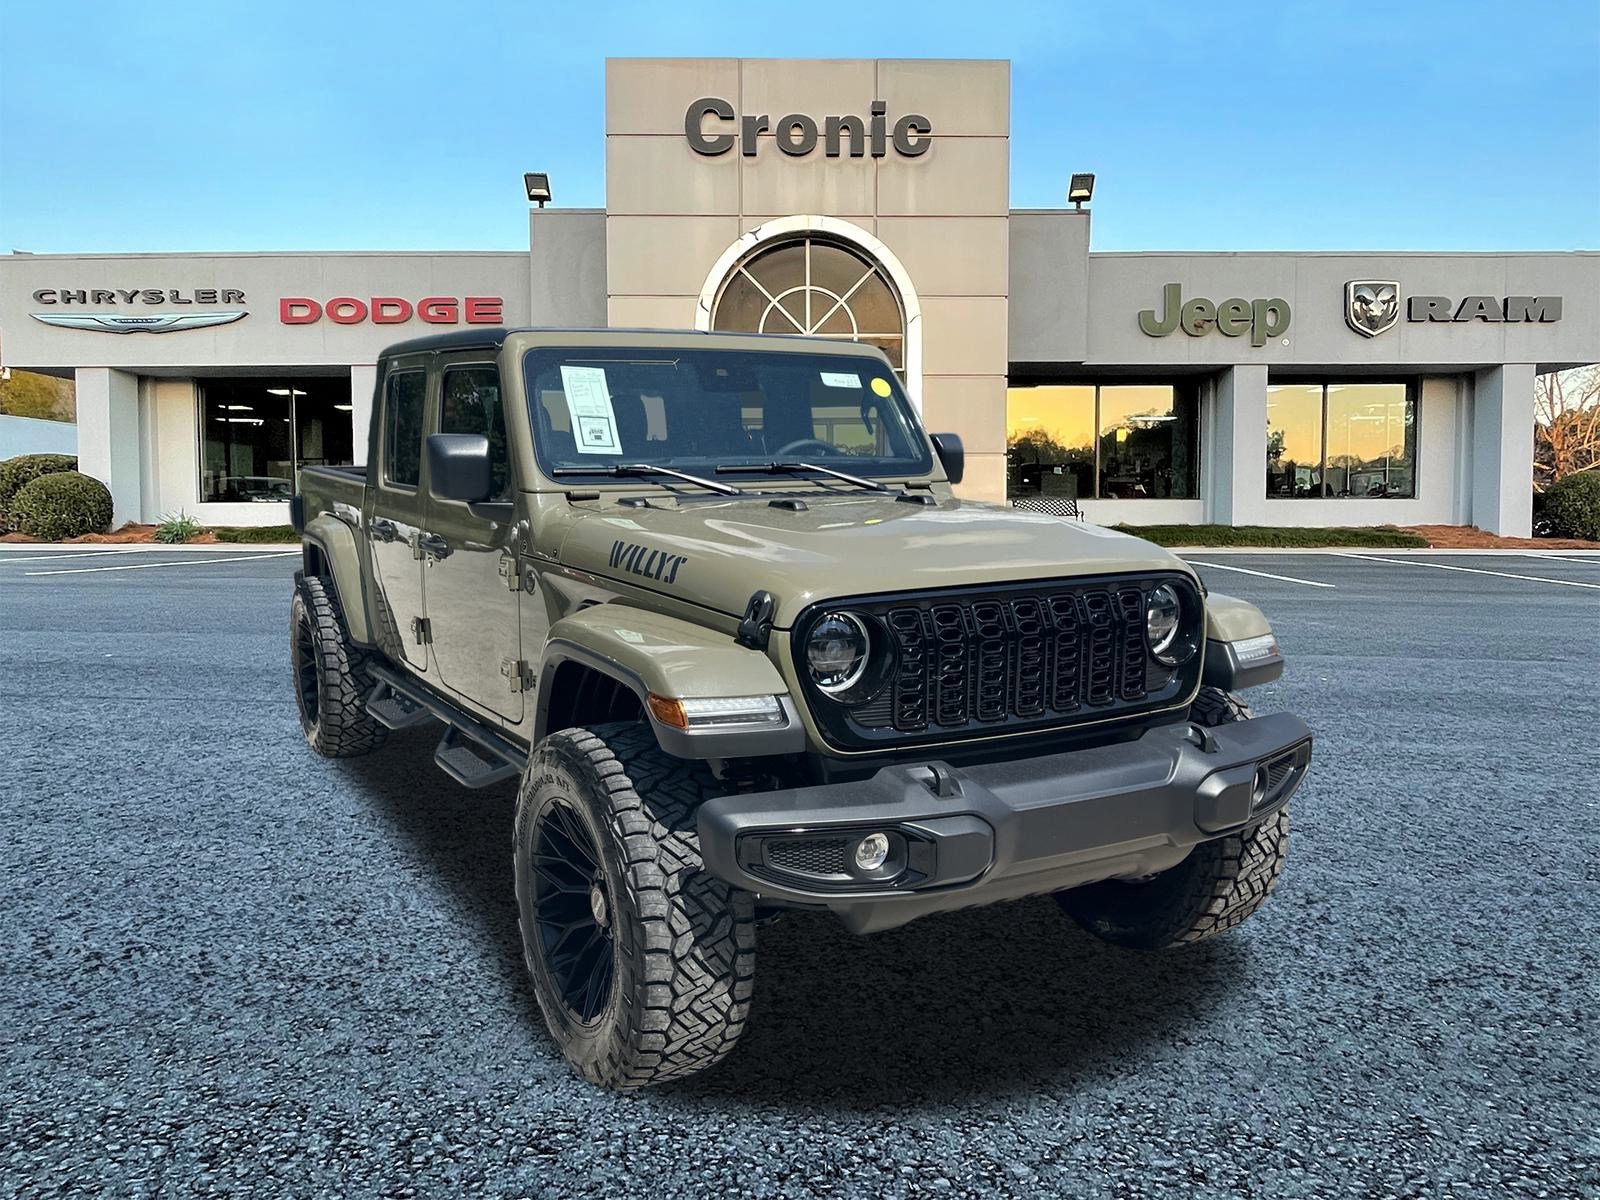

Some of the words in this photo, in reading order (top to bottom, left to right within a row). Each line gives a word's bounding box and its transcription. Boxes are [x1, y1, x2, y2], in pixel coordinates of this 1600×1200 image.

[685, 97, 932, 157] Cronic
[32, 289, 246, 304] CHRYSLER
[280, 297, 503, 325] DODGE
[1407, 296, 1563, 322] RAM
[1138, 283, 1291, 347] Jeep
[609, 540, 688, 584] WILLYS
